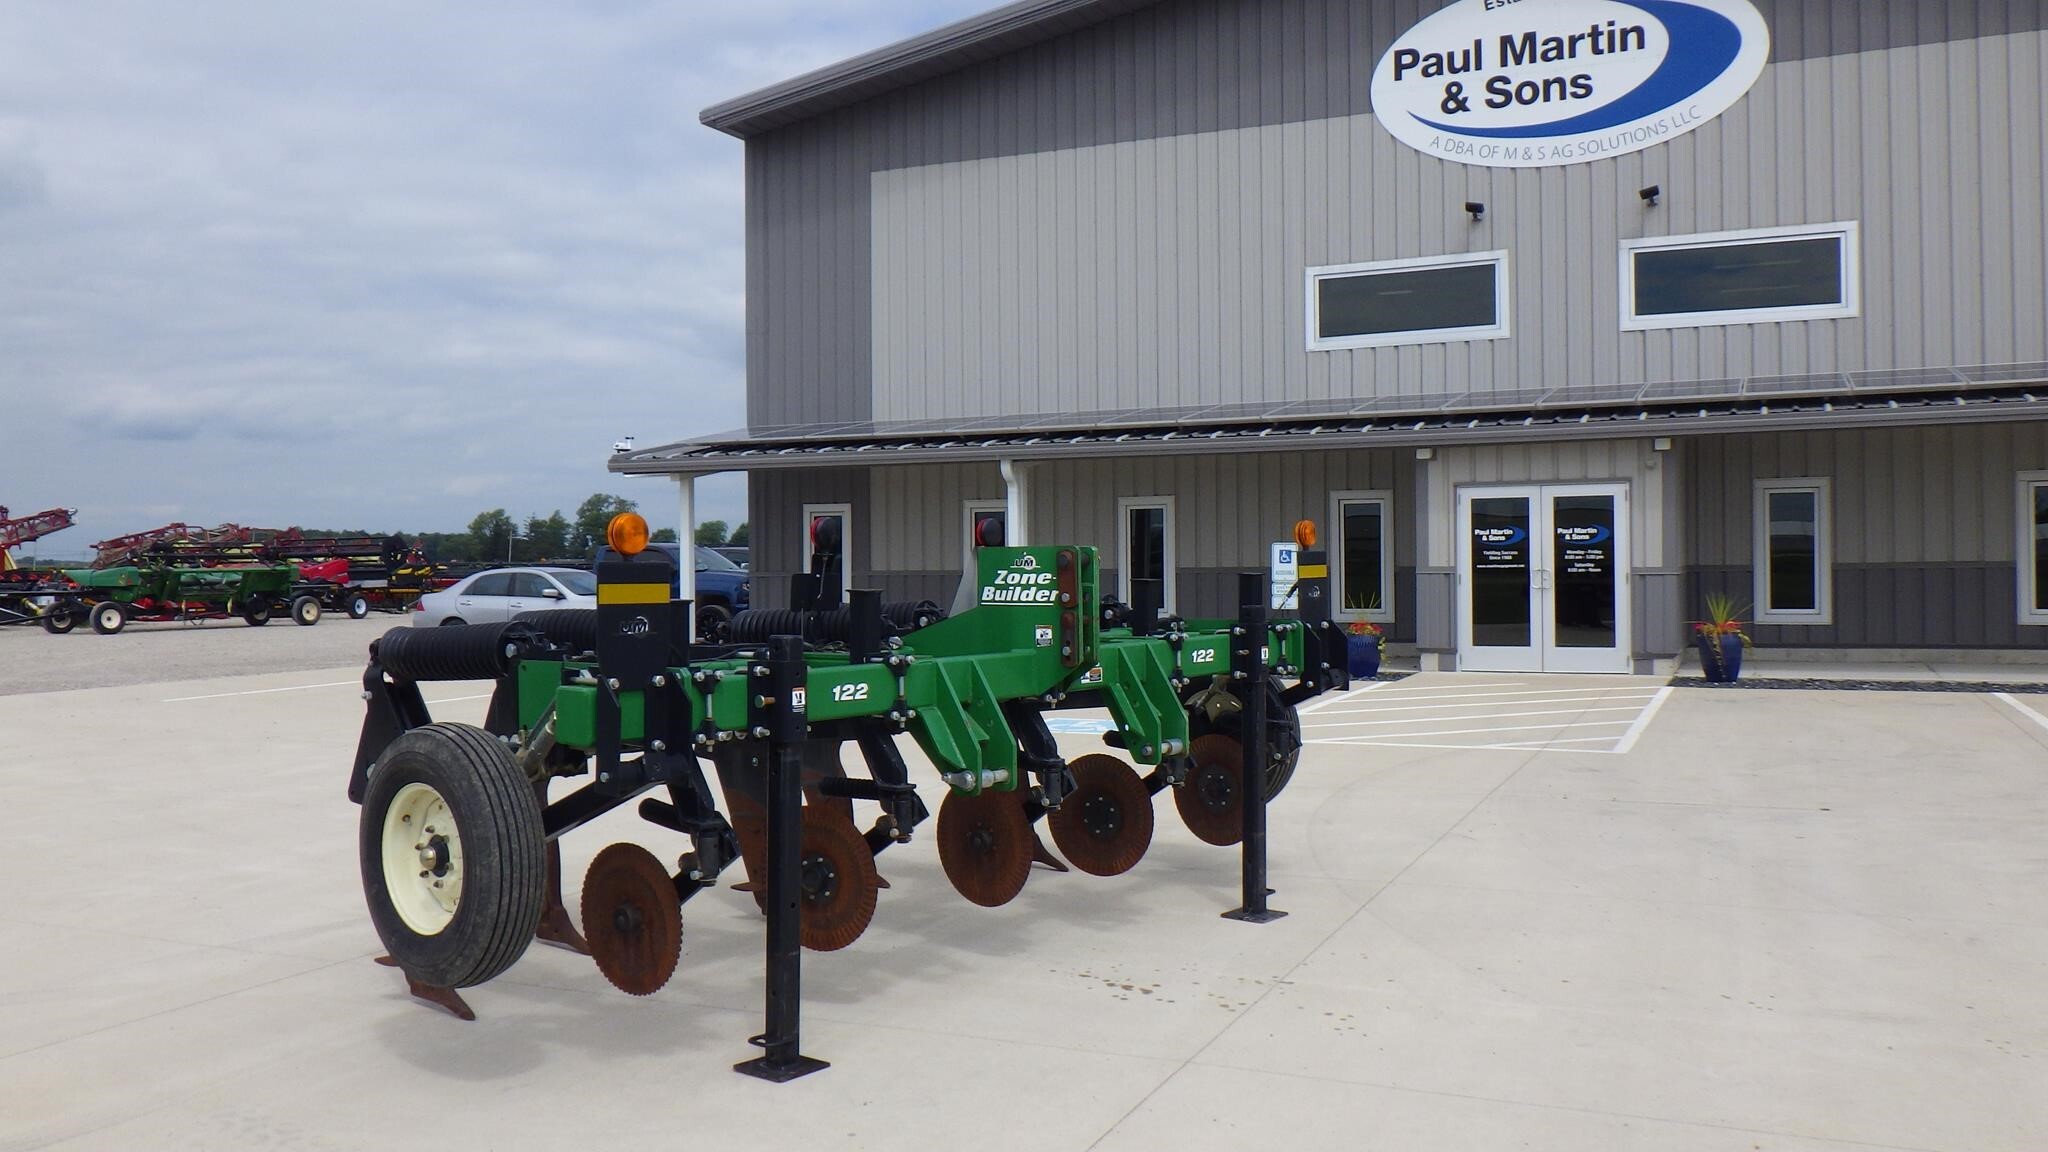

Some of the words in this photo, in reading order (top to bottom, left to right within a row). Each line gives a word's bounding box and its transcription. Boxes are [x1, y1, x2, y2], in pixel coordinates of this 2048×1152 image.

[1393, 38, 1483, 82] Paul
[1500, 20, 1645, 68] Martin
[1440, 81, 1471, 115] &
[1484, 73, 1593, 109] Sons
[1429, 136, 1440, 149] A
[1443, 138, 1474, 156] DBA
[1478, 144, 1500, 159] OF
[1503, 147, 1517, 160] M
[1521, 146, 1533, 160] &
[1537, 146, 1546, 160] S
[1551, 143, 1573, 158] AG
[1578, 119, 1669, 157] SOLUTIONS
[1671, 105, 1701, 128] LLC
[982, 586, 1059, 601] Builder
[1191, 648, 1215, 663] 122
[832, 683, 869, 701] 122
